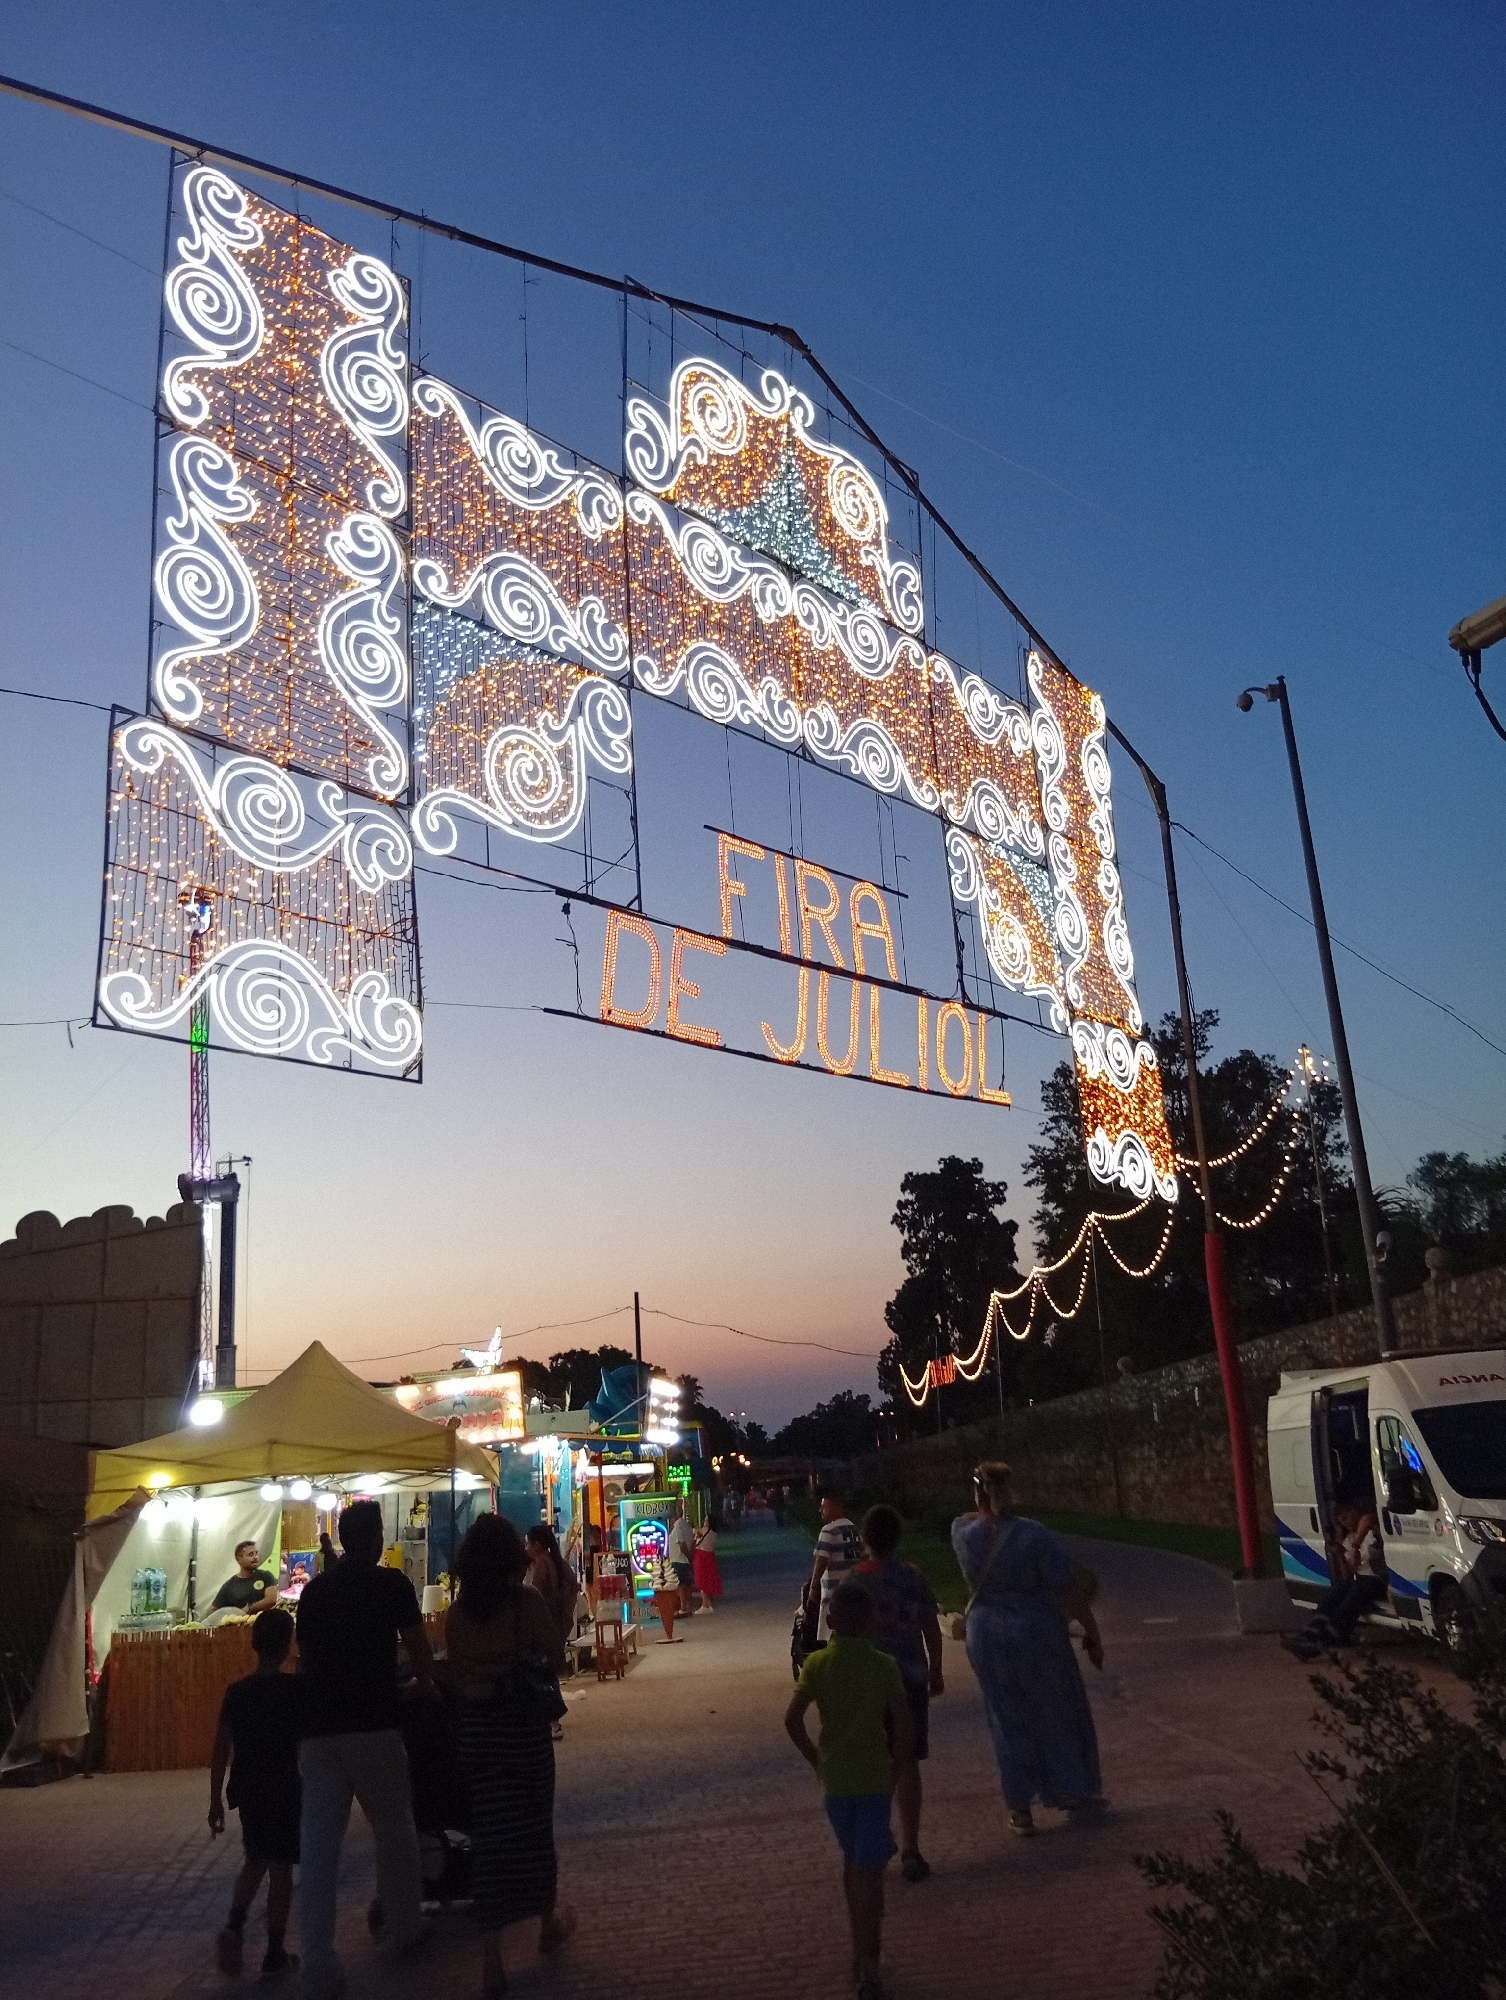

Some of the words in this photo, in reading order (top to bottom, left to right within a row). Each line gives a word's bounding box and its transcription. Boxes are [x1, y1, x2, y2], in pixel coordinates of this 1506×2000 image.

[718, 833, 899, 982] FIRA
[600, 908, 728, 1047] DE
[761, 966, 1012, 1105] JULIOL
